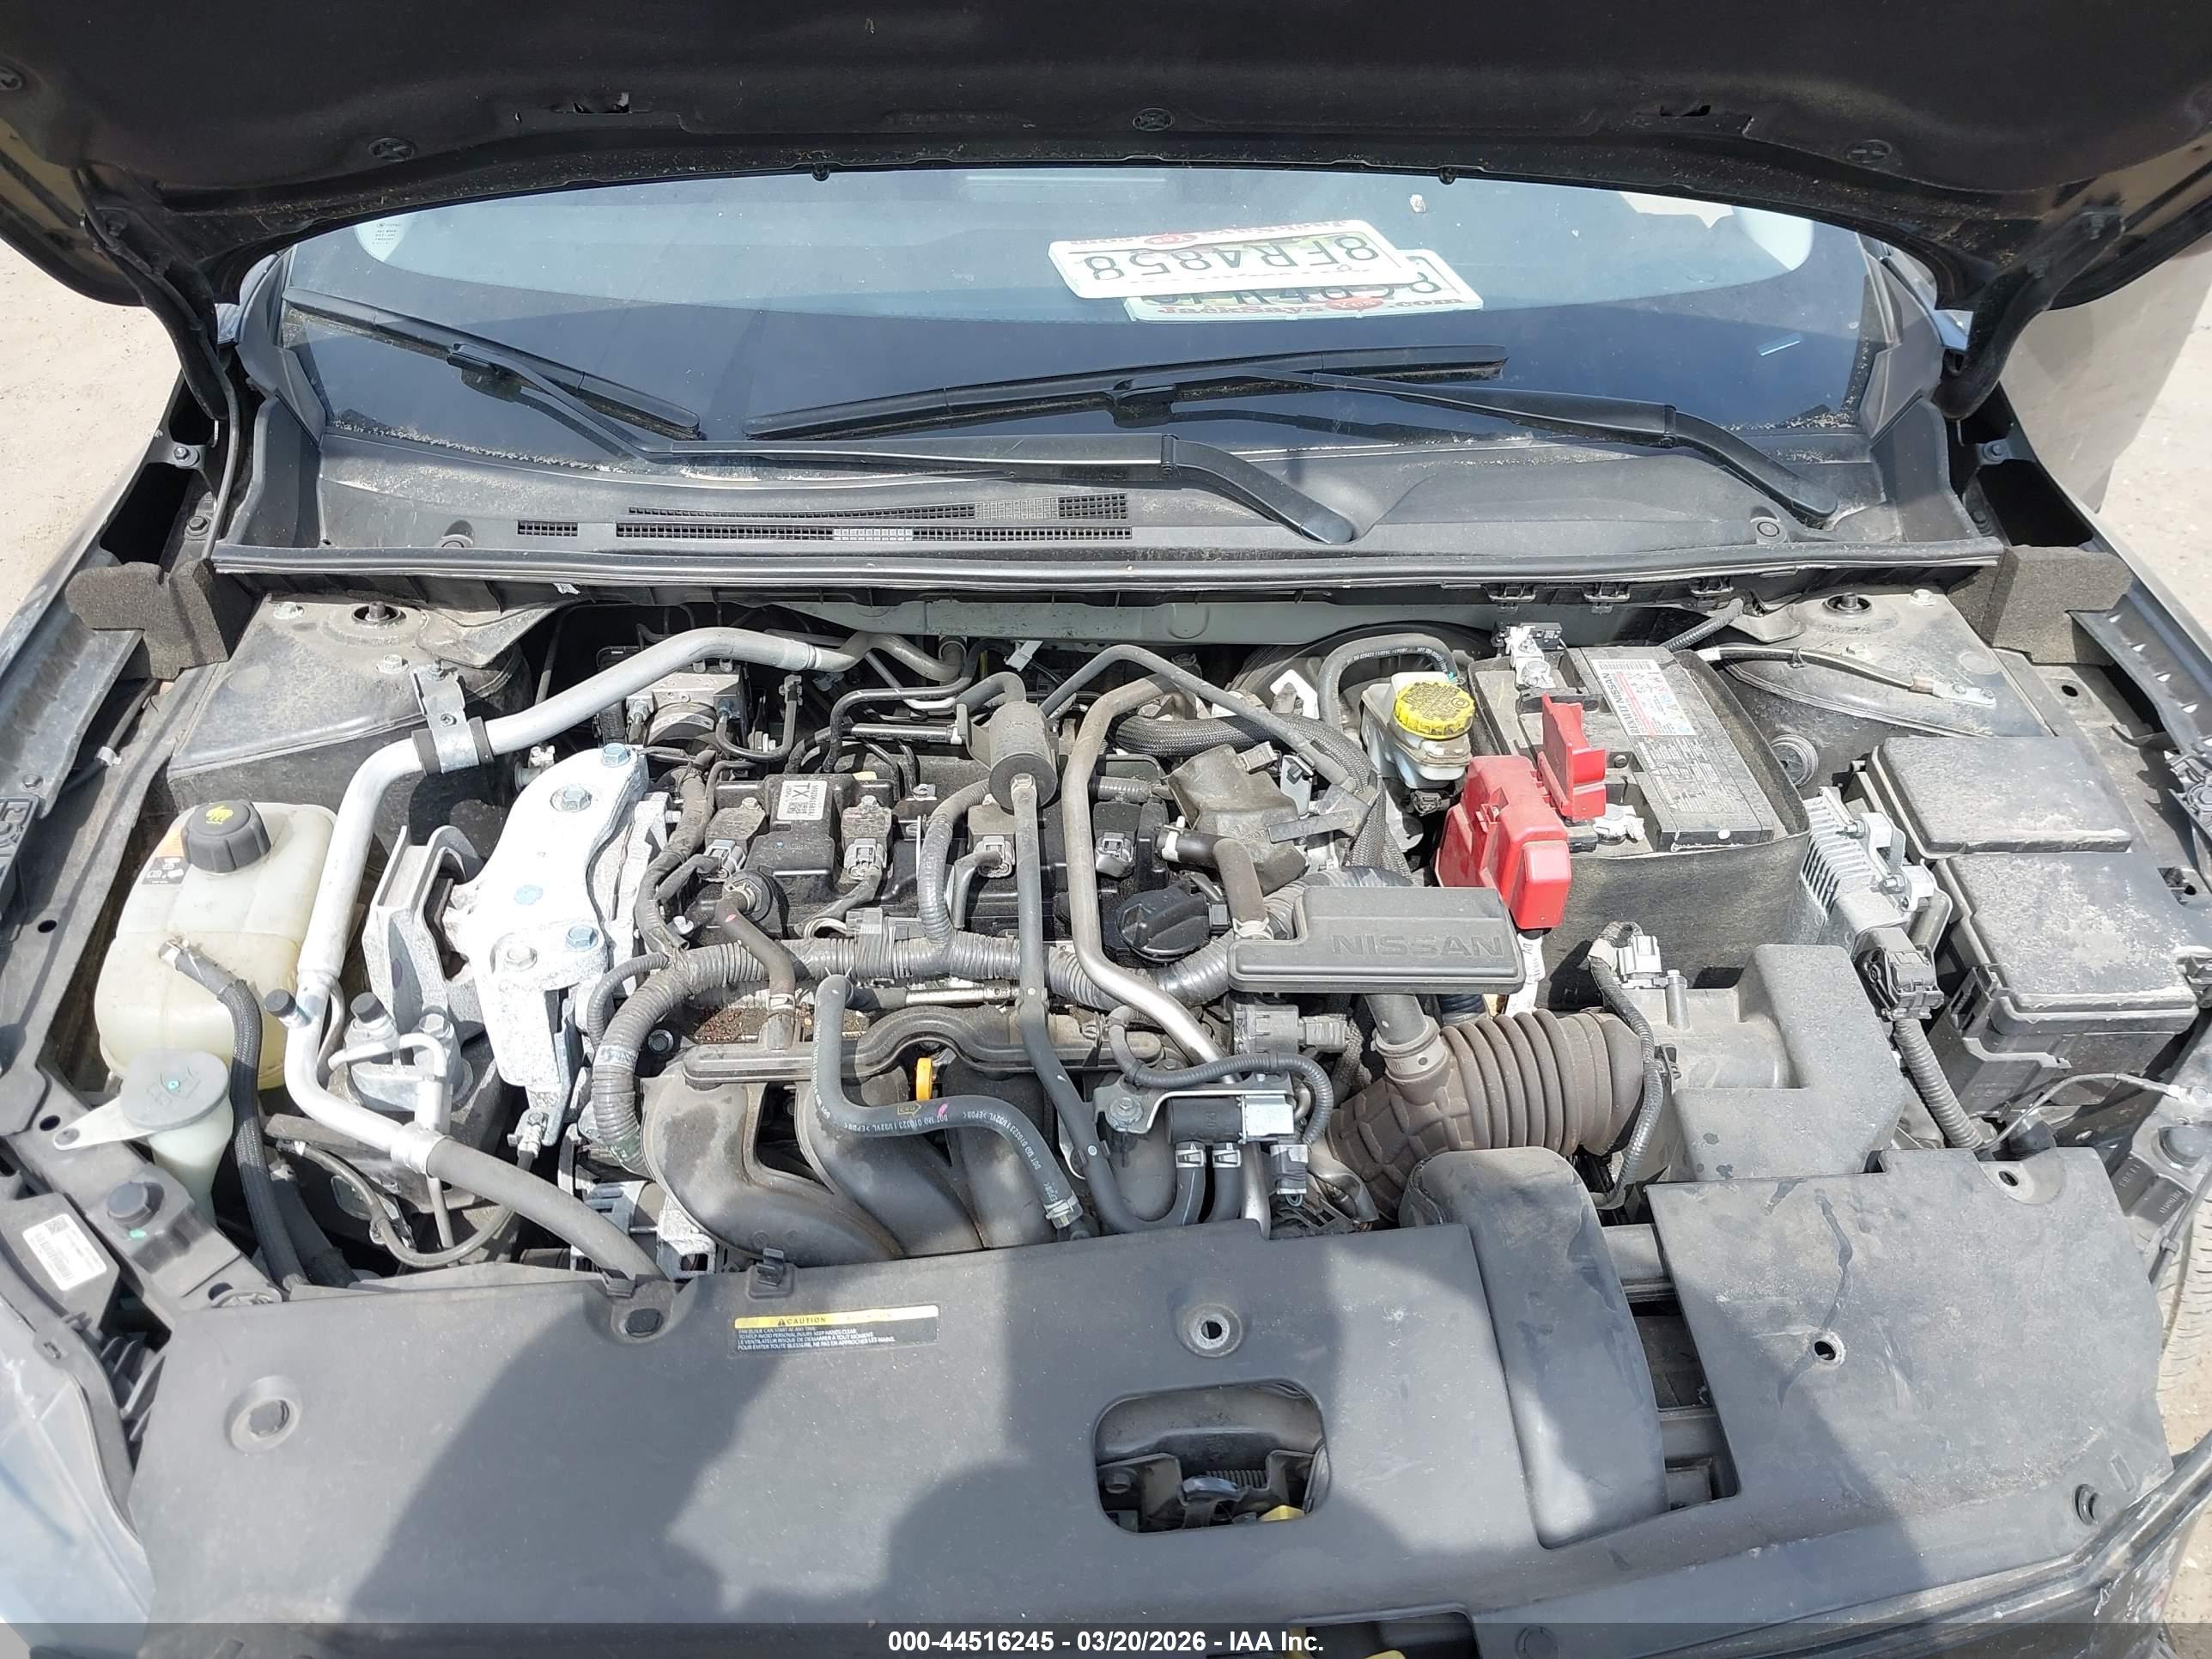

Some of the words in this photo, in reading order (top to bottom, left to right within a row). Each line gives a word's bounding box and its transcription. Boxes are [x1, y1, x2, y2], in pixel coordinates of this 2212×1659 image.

[1084, 236, 1379, 281] 8FRA858
[1158, 305, 1323, 315] JackSays
[1337, 301, 1376, 309] Yes
[1601, 672, 1624, 704] NISSAN
[792, 782, 811, 798] TX
[1332, 934, 1504, 957] NISSAN
